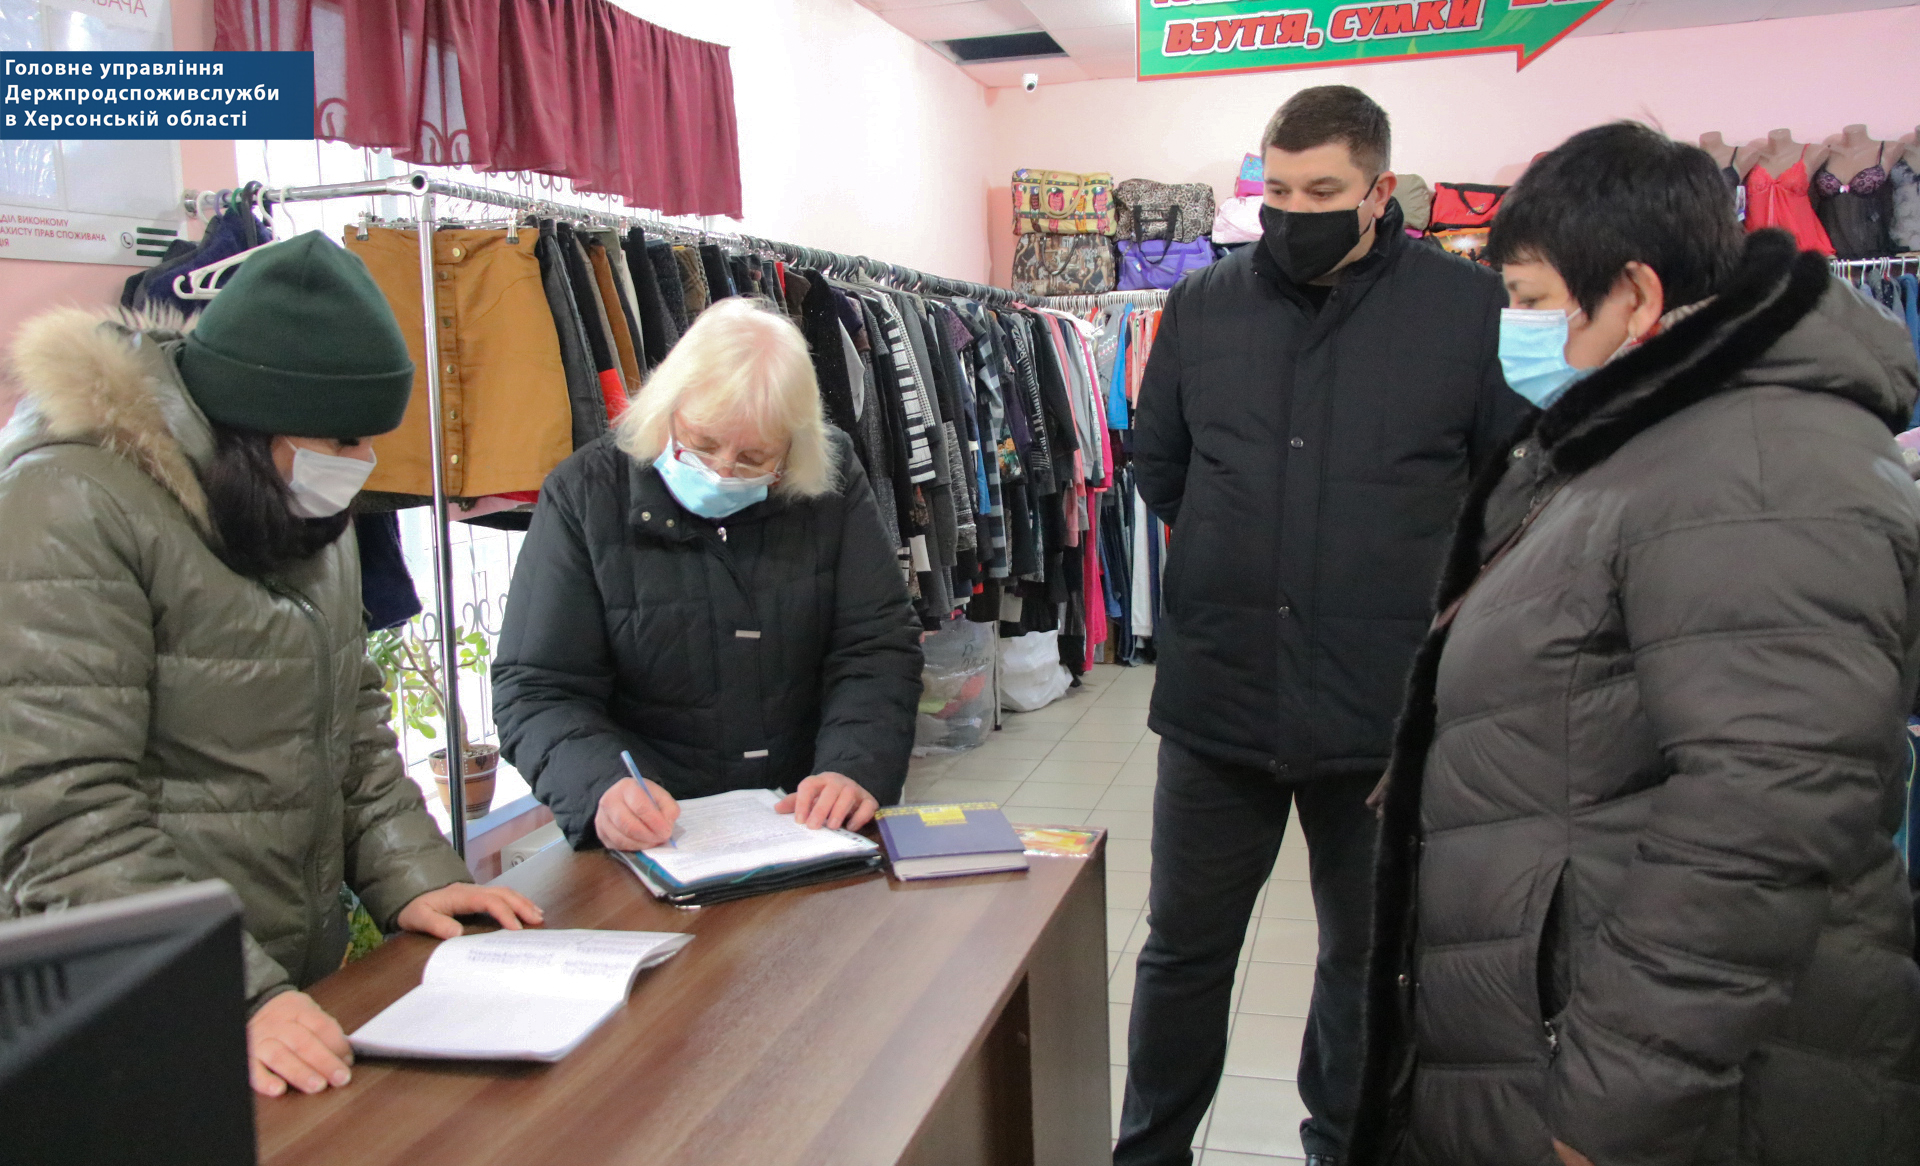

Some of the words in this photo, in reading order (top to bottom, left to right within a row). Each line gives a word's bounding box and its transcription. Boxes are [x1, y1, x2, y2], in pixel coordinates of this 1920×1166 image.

[1164, 12, 1321, 53] ВЗУТТЯ,
[1330, 0, 1483, 39] СУМКИ
[0, 213, 16, 223] ДІЛ
[17, 215, 69, 227] ВИКОНКОМУ
[34, 228, 55, 238] ПРАВ
[56, 230, 107, 241] СПОЖИВАЧА
